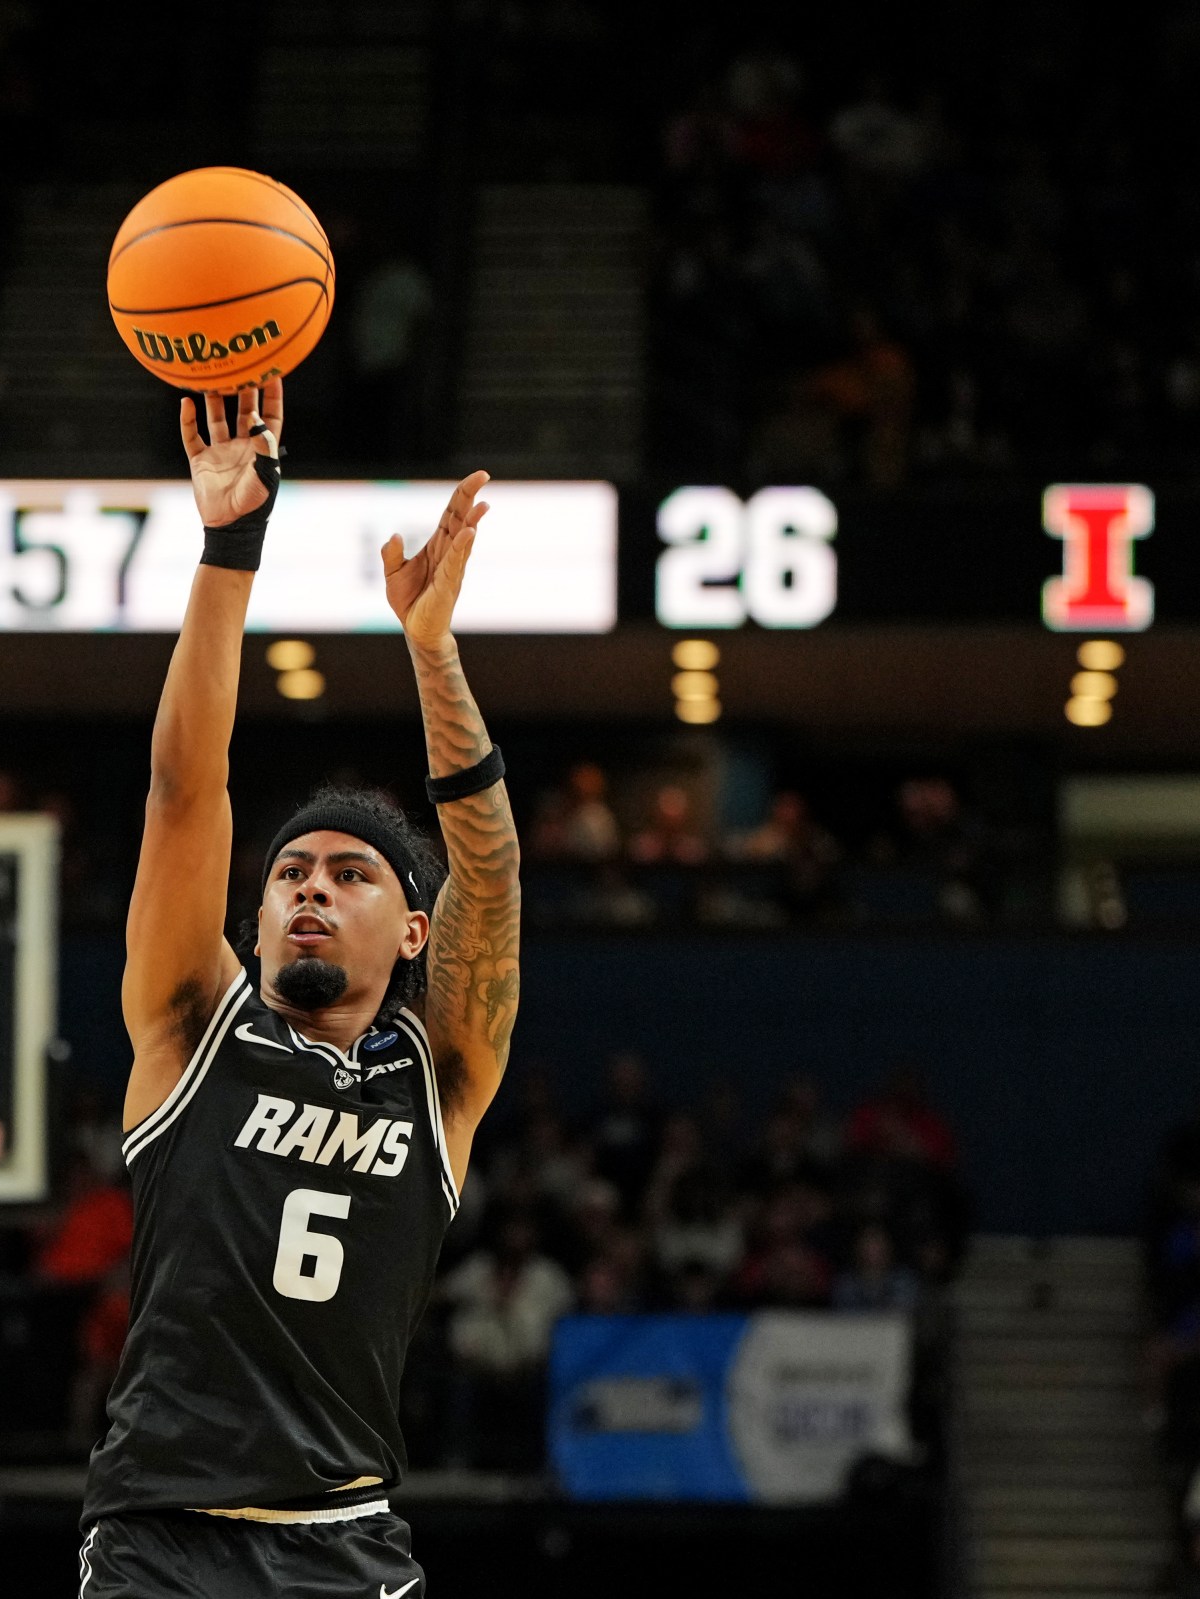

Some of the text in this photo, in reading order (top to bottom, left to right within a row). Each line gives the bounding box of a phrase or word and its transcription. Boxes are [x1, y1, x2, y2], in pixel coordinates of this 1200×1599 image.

[133, 319, 282, 364] Wilson
[655, 485, 838, 629] 26
[370, 1033, 398, 1049] NCAA
[234, 1093, 414, 1177] RAMS
[273, 1188, 351, 1302] 6
